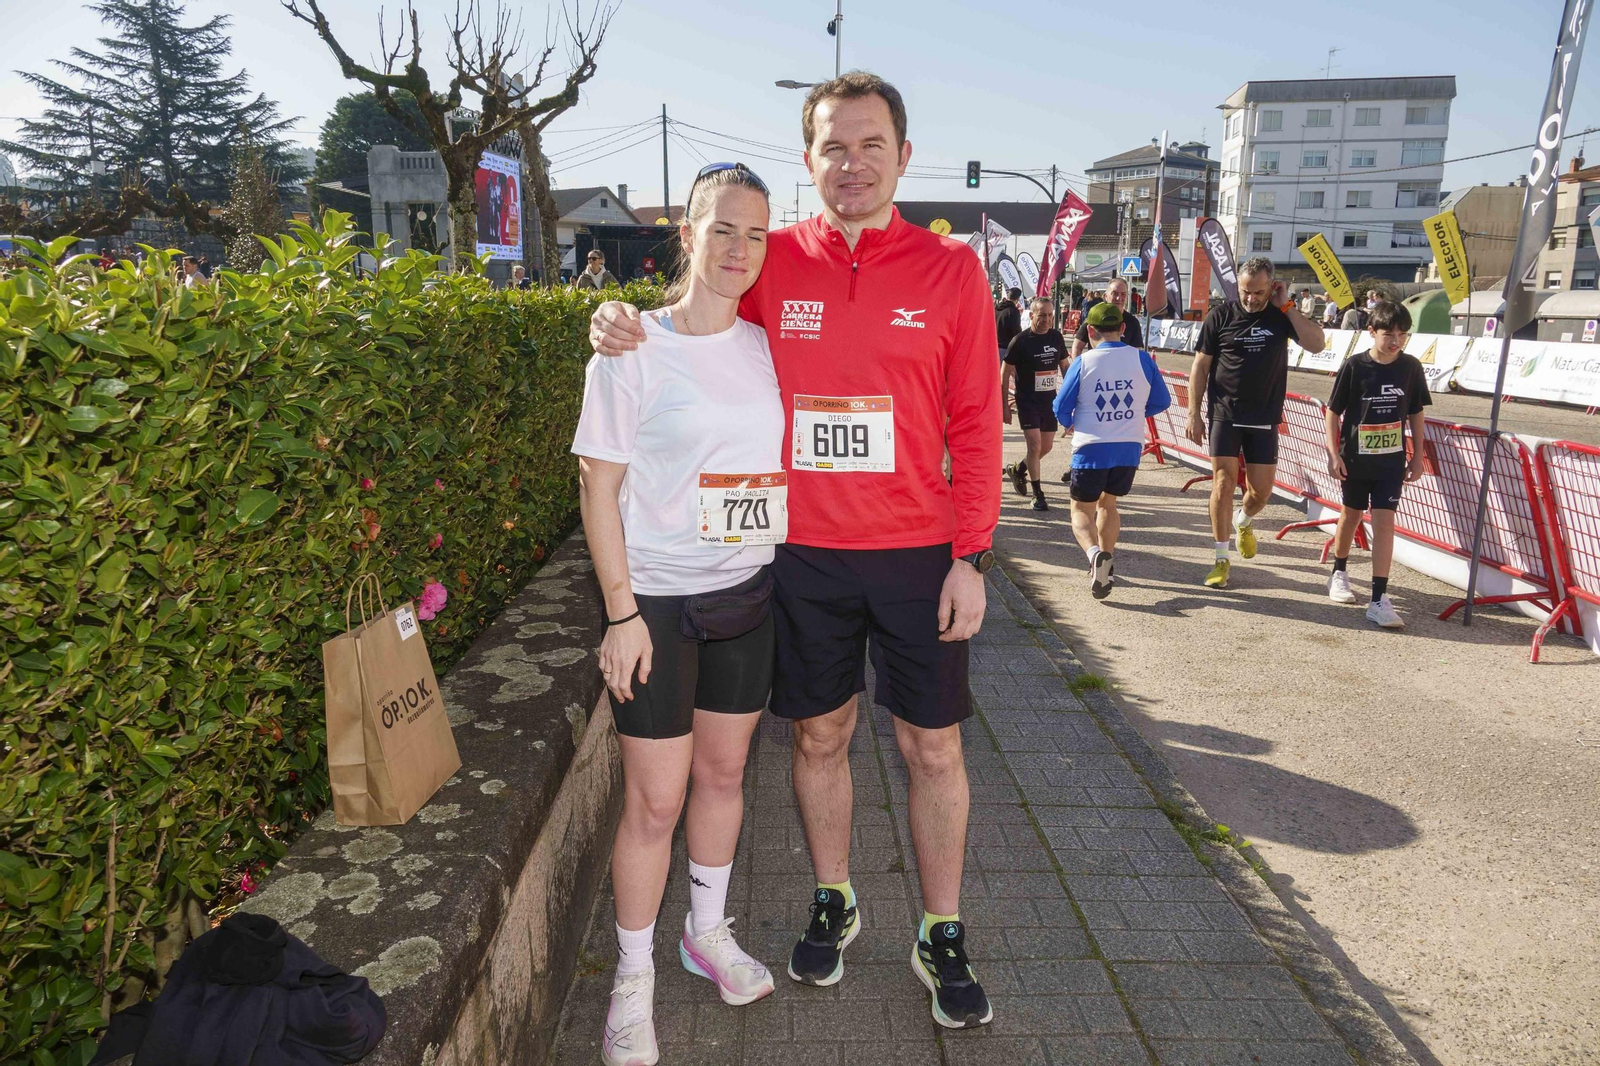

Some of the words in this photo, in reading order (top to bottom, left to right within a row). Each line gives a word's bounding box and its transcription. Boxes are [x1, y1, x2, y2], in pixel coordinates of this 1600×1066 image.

[1434, 221, 1461, 279] ELECPOR
[1307, 244, 1341, 289] ELECPOR
[780, 320, 822, 328] CIENCIA
[1094, 378, 1134, 393] ÁLEX
[828, 414, 852, 422] DIEGO
[1095, 409, 1134, 422] VIGO
[813, 423, 869, 458] 609
[1365, 433, 1398, 449] 2262
[725, 489, 740, 497] PAO
[744, 489, 770, 497] PAOLITA
[723, 498, 770, 531] 720
